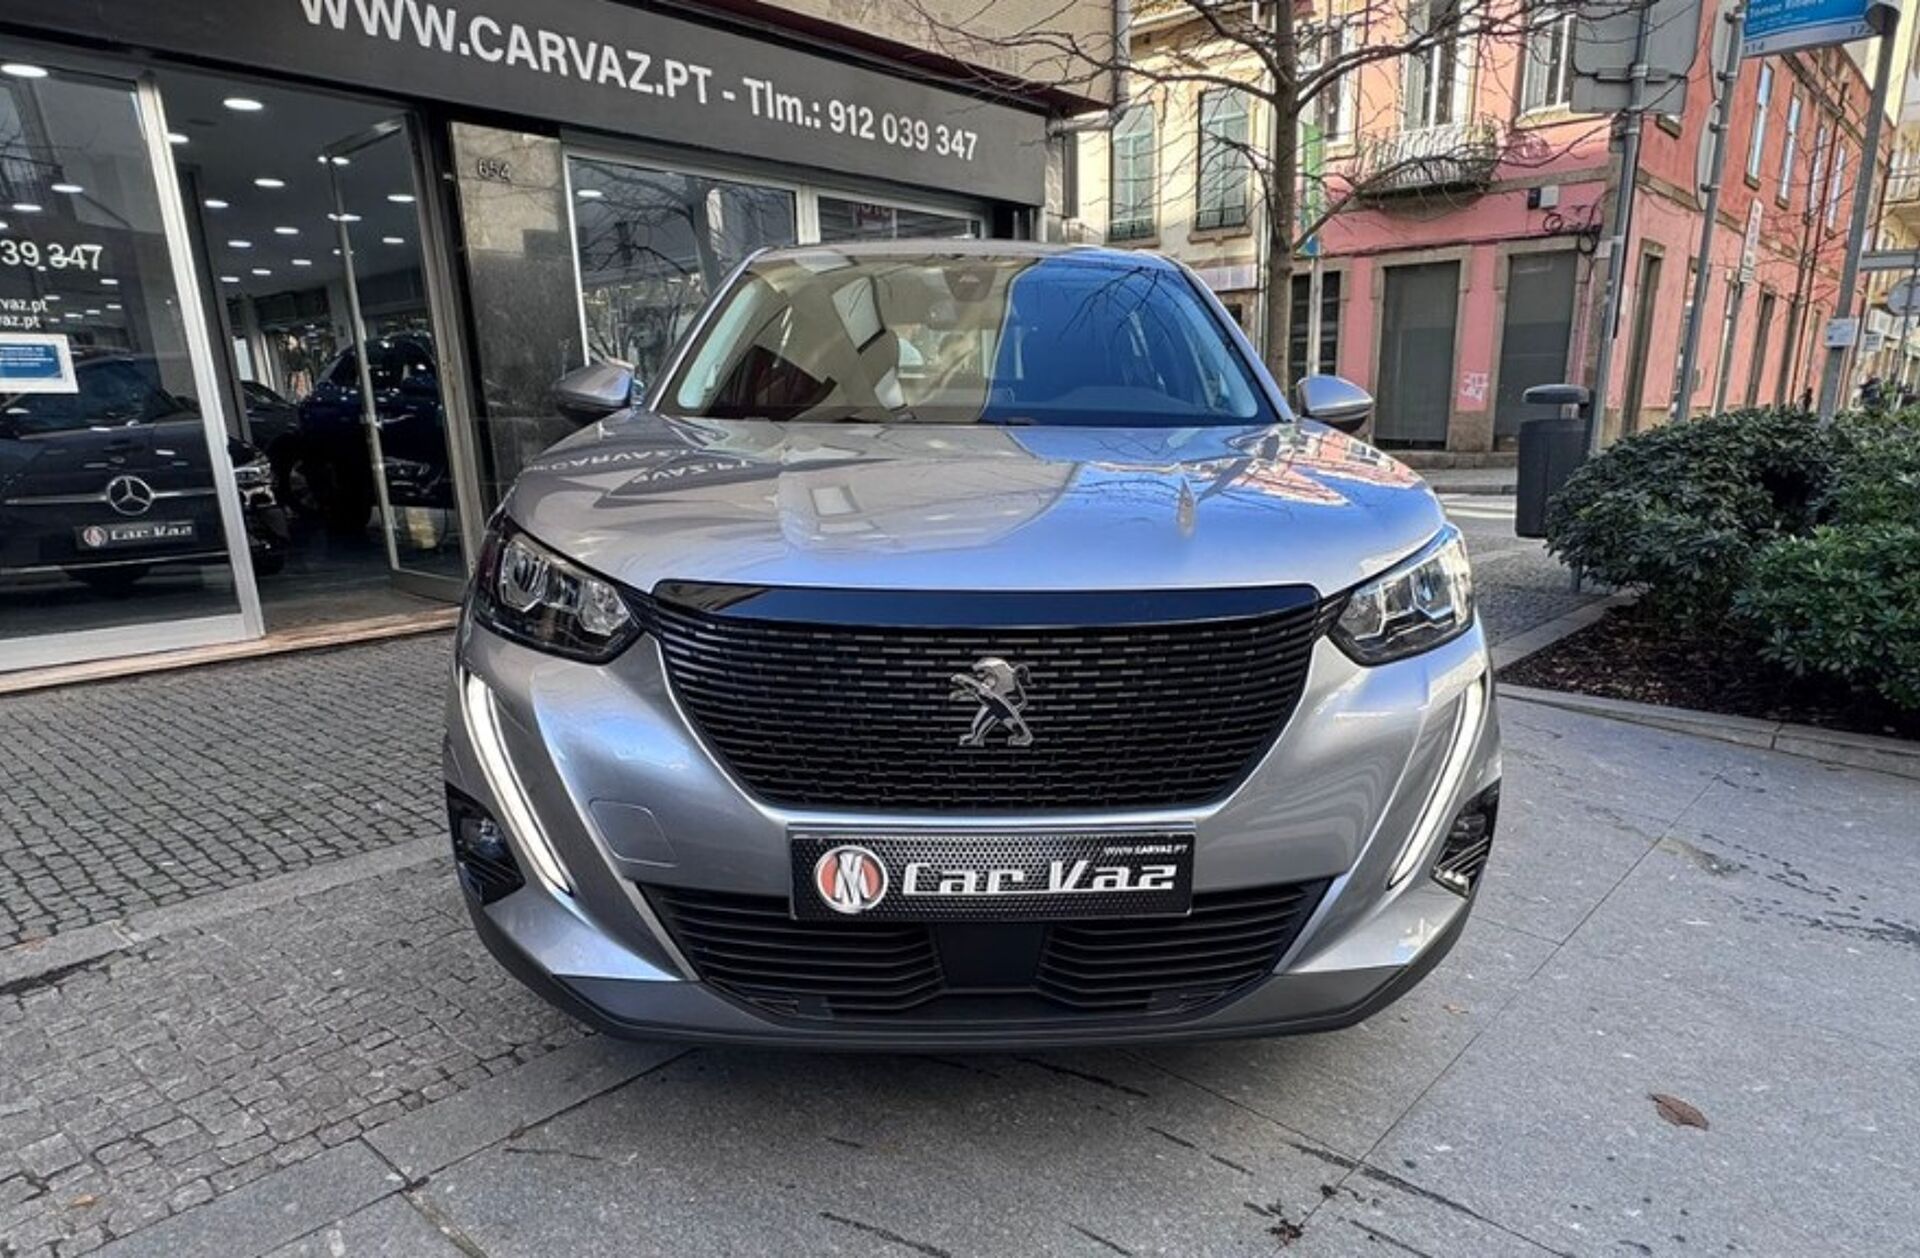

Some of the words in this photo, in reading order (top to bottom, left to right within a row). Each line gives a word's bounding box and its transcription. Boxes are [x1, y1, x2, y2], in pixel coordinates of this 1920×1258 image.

[300, 0, 712, 104] WWW.CARVAZ.PT
[743, 77, 822, 129] Tlm.:
[828, 99, 875, 140] 912
[881, 112, 929, 151] 039
[935, 124, 978, 161] 347
[46, 243, 103, 271] 347
[0, 316, 41, 330] az.pt
[903, 862, 1024, 896] Car
